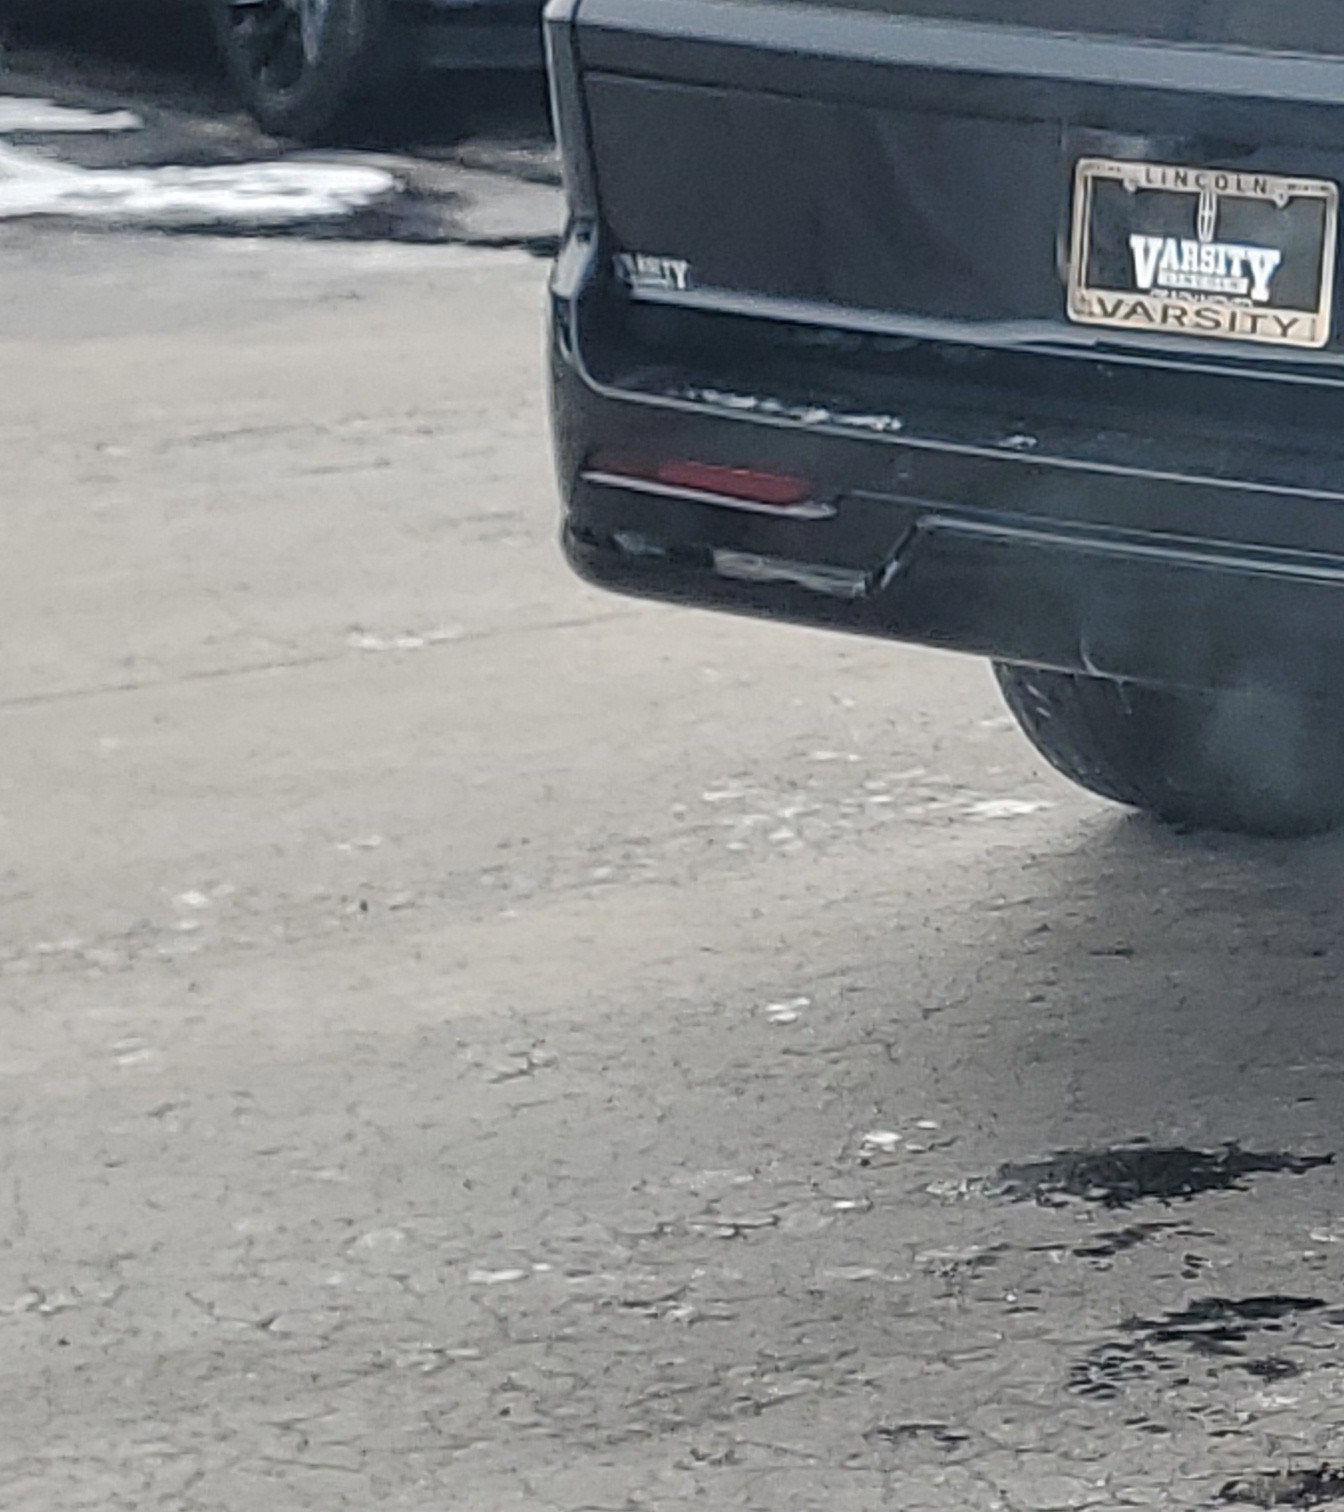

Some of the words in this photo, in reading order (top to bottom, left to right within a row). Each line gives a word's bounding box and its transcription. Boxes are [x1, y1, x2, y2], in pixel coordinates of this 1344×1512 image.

[1143, 169, 1269, 194] LINCOLN
[1128, 233, 1281, 302] VARSITY
[1096, 296, 1300, 338] VARSITY
